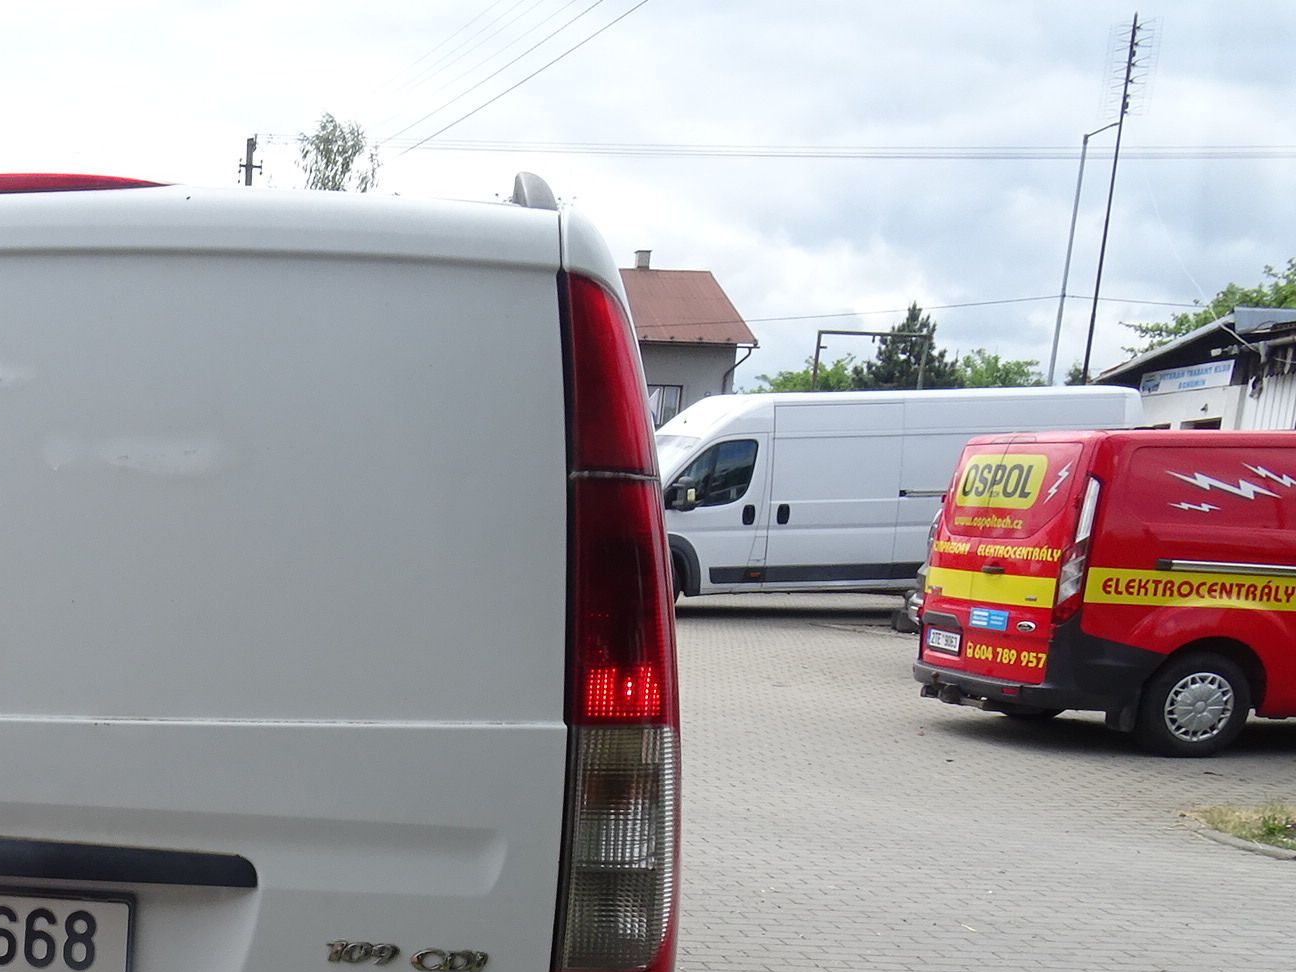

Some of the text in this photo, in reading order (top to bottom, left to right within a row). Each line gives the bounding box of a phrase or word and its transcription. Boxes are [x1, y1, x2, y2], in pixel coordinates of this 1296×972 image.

[961, 463, 1034, 499] OSPOL
[977, 544, 1062, 562] ELEKTROCENTRÁLY
[1102, 577, 1296, 604] ELEKTROCENTRÁLY
[974, 644, 1047, 668] 604 789 957
[326, 938, 401, 966] 109
